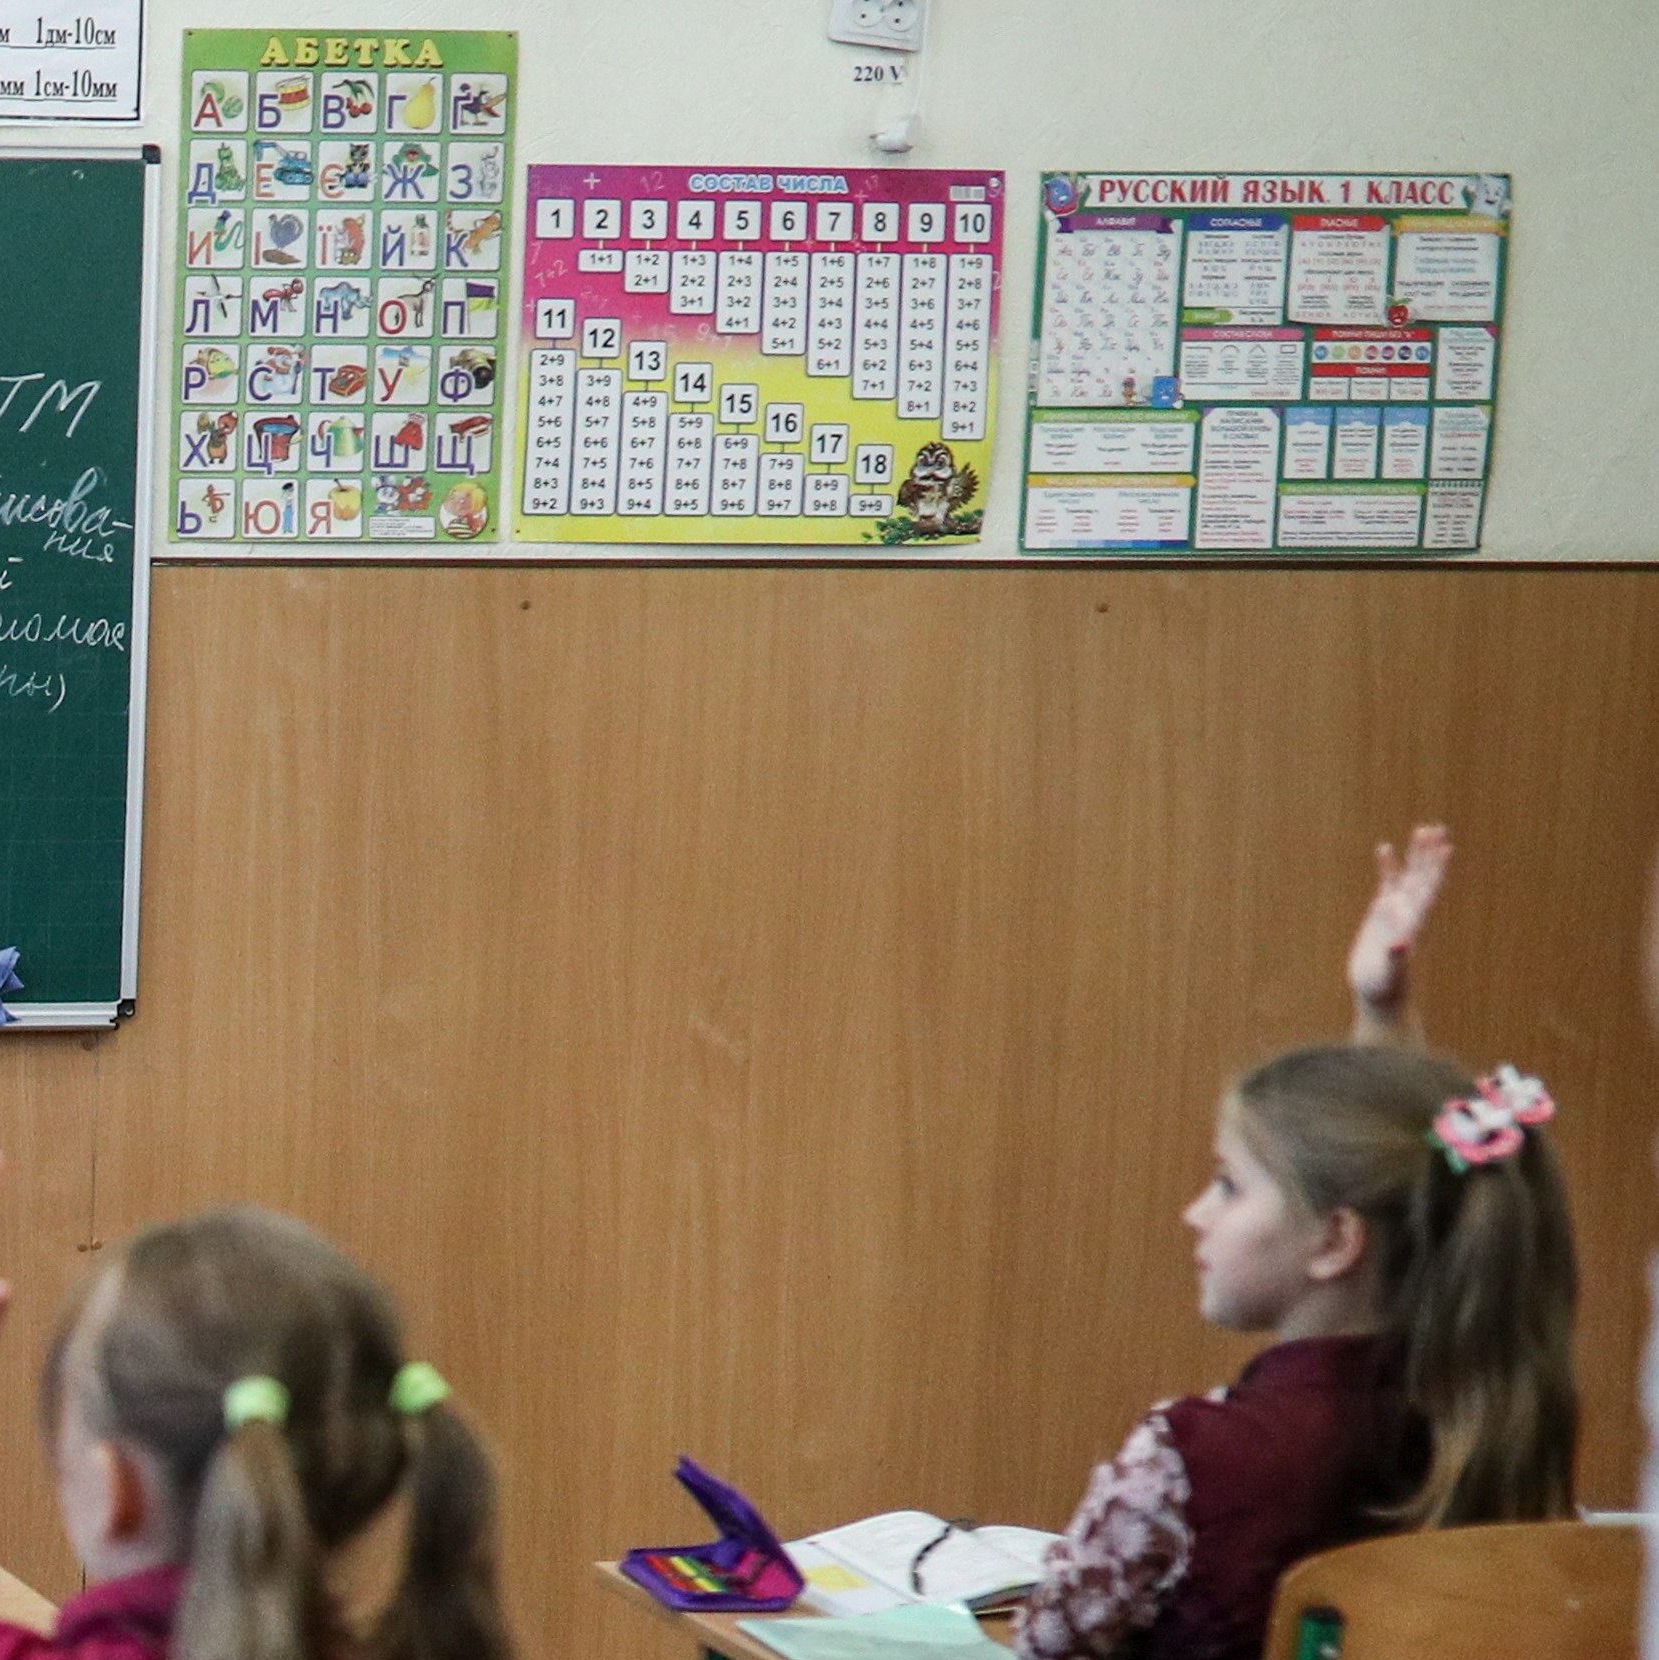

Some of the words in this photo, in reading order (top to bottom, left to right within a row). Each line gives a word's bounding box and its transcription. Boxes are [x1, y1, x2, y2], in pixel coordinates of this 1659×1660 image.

[37, 17, 116, 47] 1дм-10см
[260, 37, 444, 68] АБЕТКА
[854, 66, 883, 82] 220
[36, 70, 117, 97] 1см-10мм
[689, 174, 772, 193] СОСТАВ
[778, 174, 849, 194] ЧИСЛА
[1099, 173, 1230, 203] РУССКИЙ
[1242, 180, 1323, 203] ЯЗЫК
[1341, 180, 1350, 203] 1
[1367, 181, 1455, 204] КЛАСС
[551, 208, 561, 229] 1
[595, 208, 609, 230] 2
[642, 208, 655, 230] 3
[688, 210, 703, 230] 4
[736, 210, 749, 231] 5
[782, 210, 795, 231] 6
[828, 211, 841, 232] 7
[873, 211, 887, 233] 8
[920, 212, 933, 233] 9
[959, 212, 986, 234] 10
[1097, 217, 1136, 225] АЛФАВИТ
[1210, 218, 1262, 227] СОГЛАСНЫЕ
[589, 253, 613, 265] 1+1
[636, 253, 660, 266] 1+2
[682, 253, 707, 267] 1+3
[728, 255, 753, 266] 1+4
[633, 274, 658, 287] 2+1
[680, 274, 706, 287] 2+2
[727, 274, 752, 288] 2+3
[680, 295, 703, 308] 3+1
[727, 295, 752, 308] 3+2
[543, 308, 566, 329] 11
[725, 316, 749, 328] 4+1
[589, 328, 615, 348] 12
[634, 350, 661, 371] 13
[680, 372, 707, 393] 14
[725, 393, 752, 414] 15
[771, 412, 798, 433] 16
[816, 433, 843, 454] 17
[769, 458, 794, 471] 7+9
[861, 453, 887, 475] 18
[768, 478, 793, 491] 8+8
[814, 479, 839, 492] 8+9
[766, 499, 792, 511] 9+7
[813, 499, 837, 512] 9+8
[858, 499, 883, 512] 9+9
